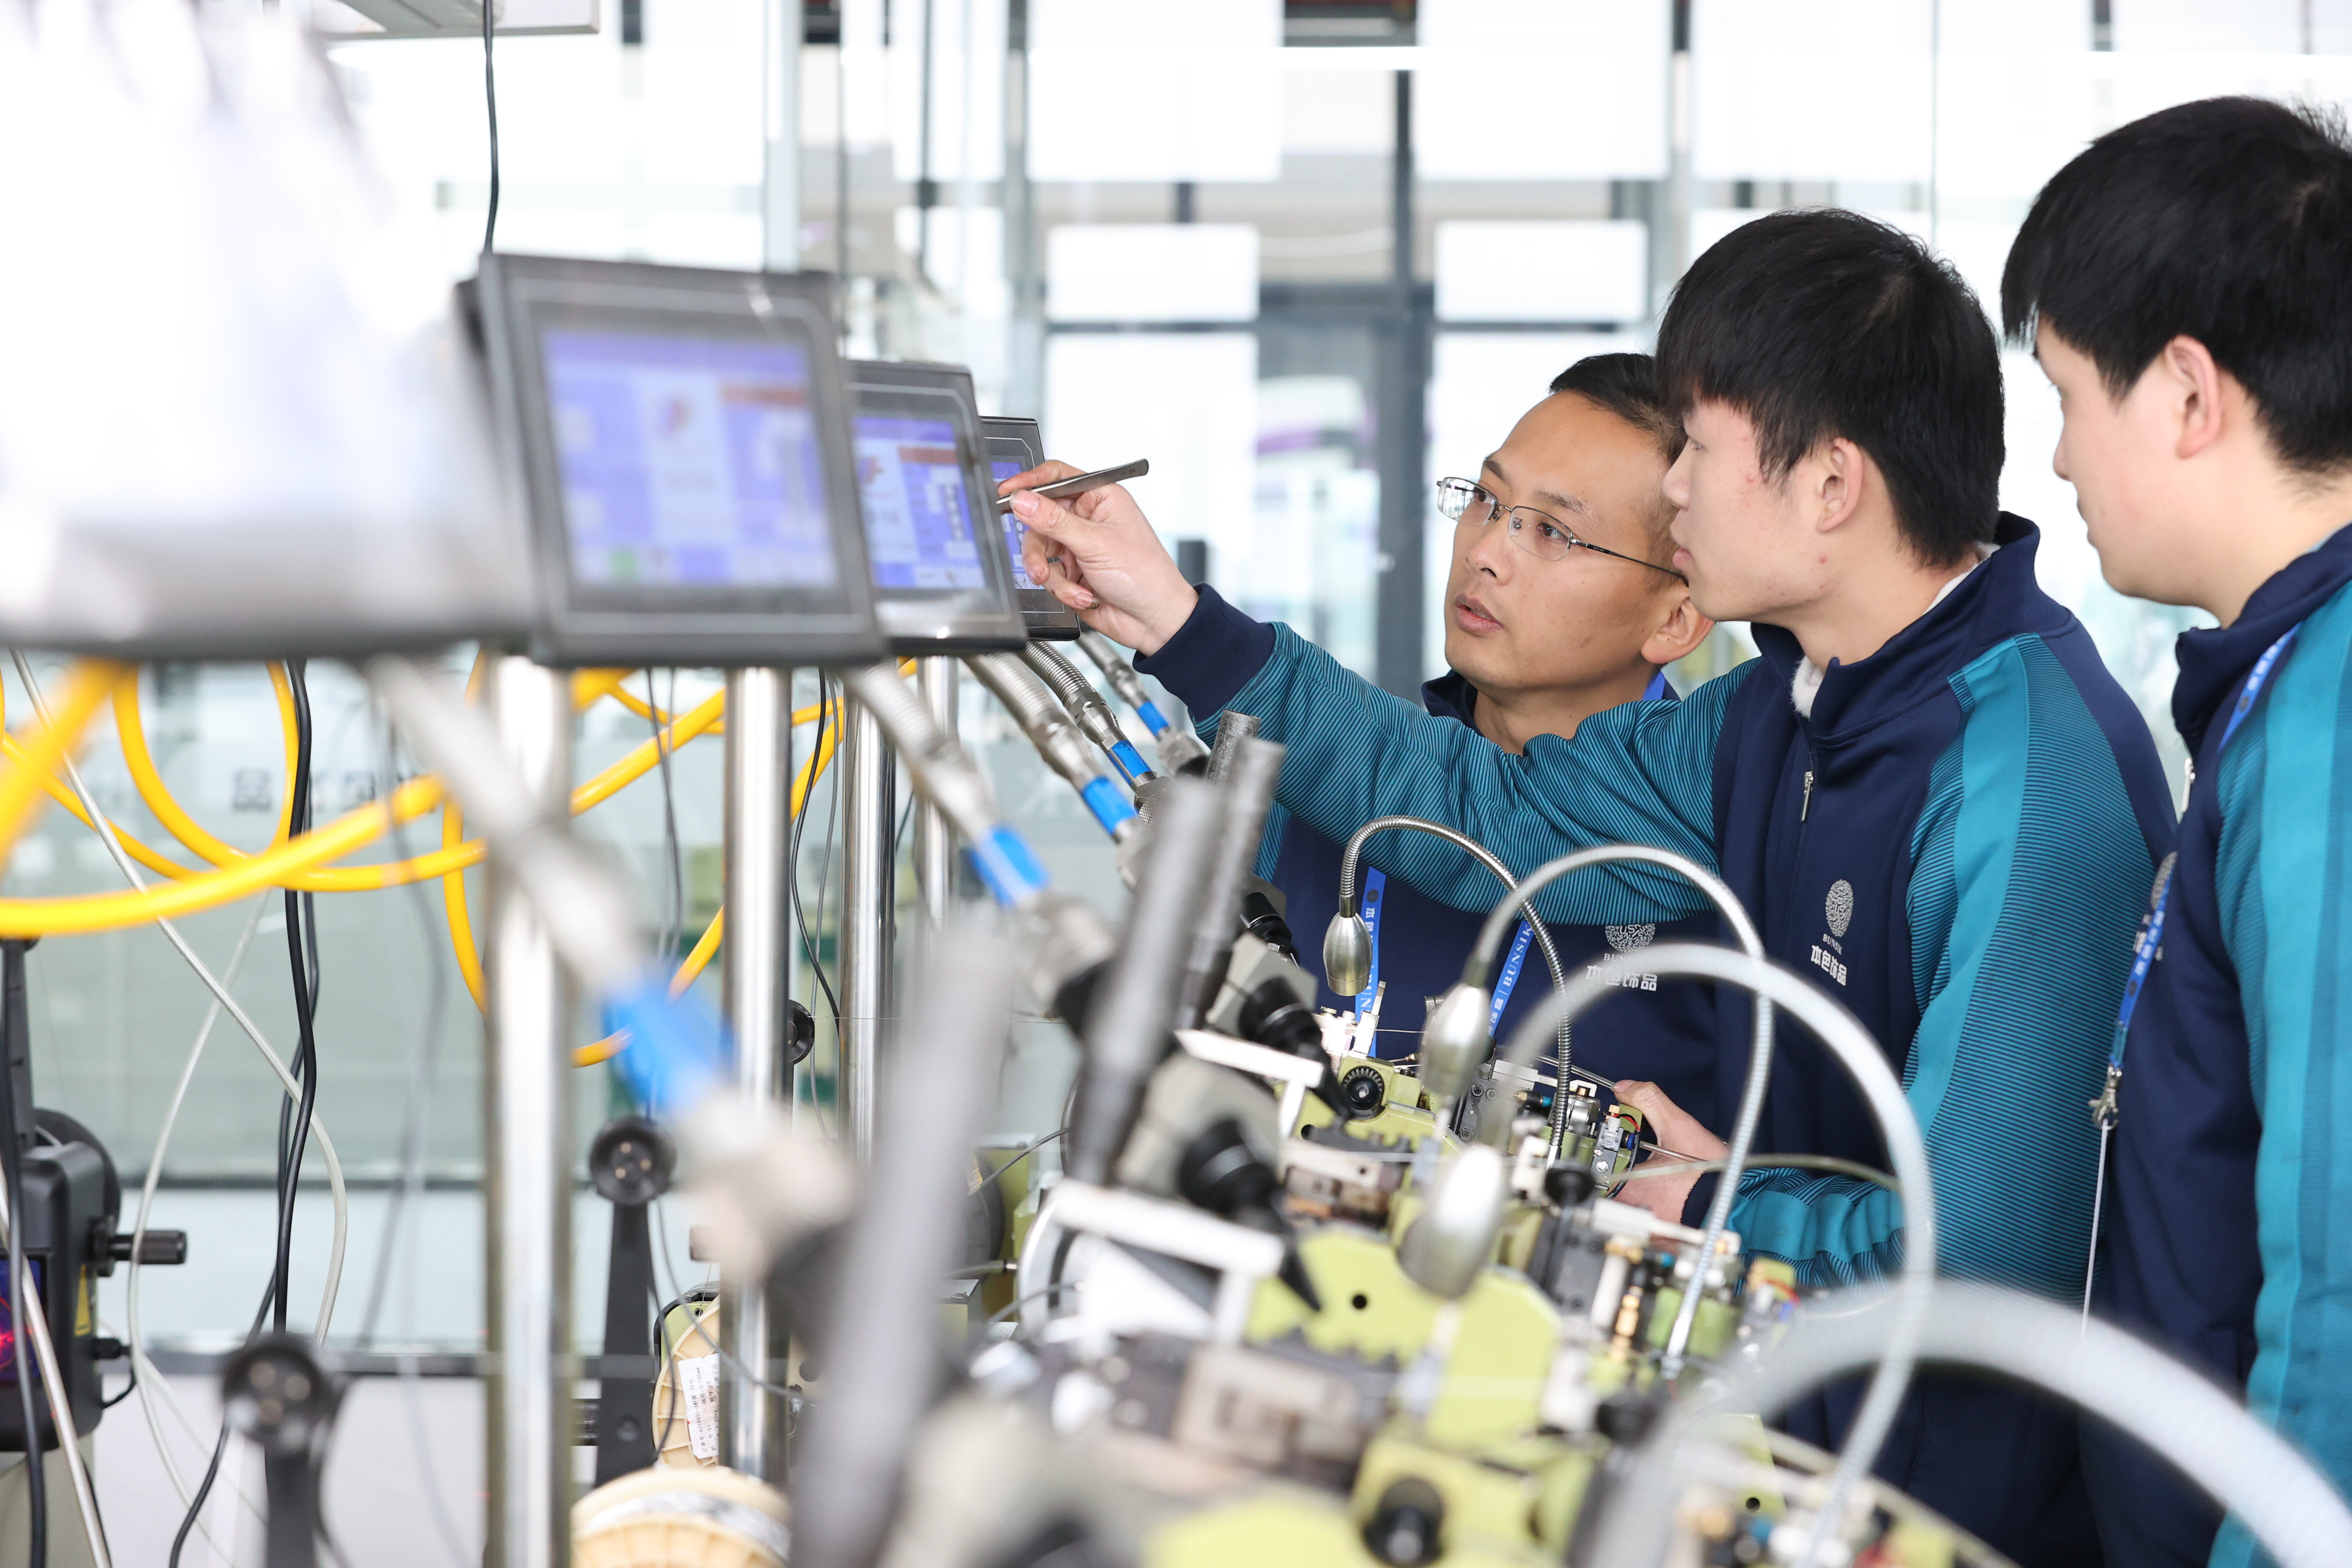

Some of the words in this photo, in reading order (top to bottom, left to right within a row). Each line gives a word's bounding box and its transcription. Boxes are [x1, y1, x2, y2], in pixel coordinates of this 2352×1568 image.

[1503, 924, 1532, 987] BUNSIK
[1811, 945, 1847, 986] 本色饰品
